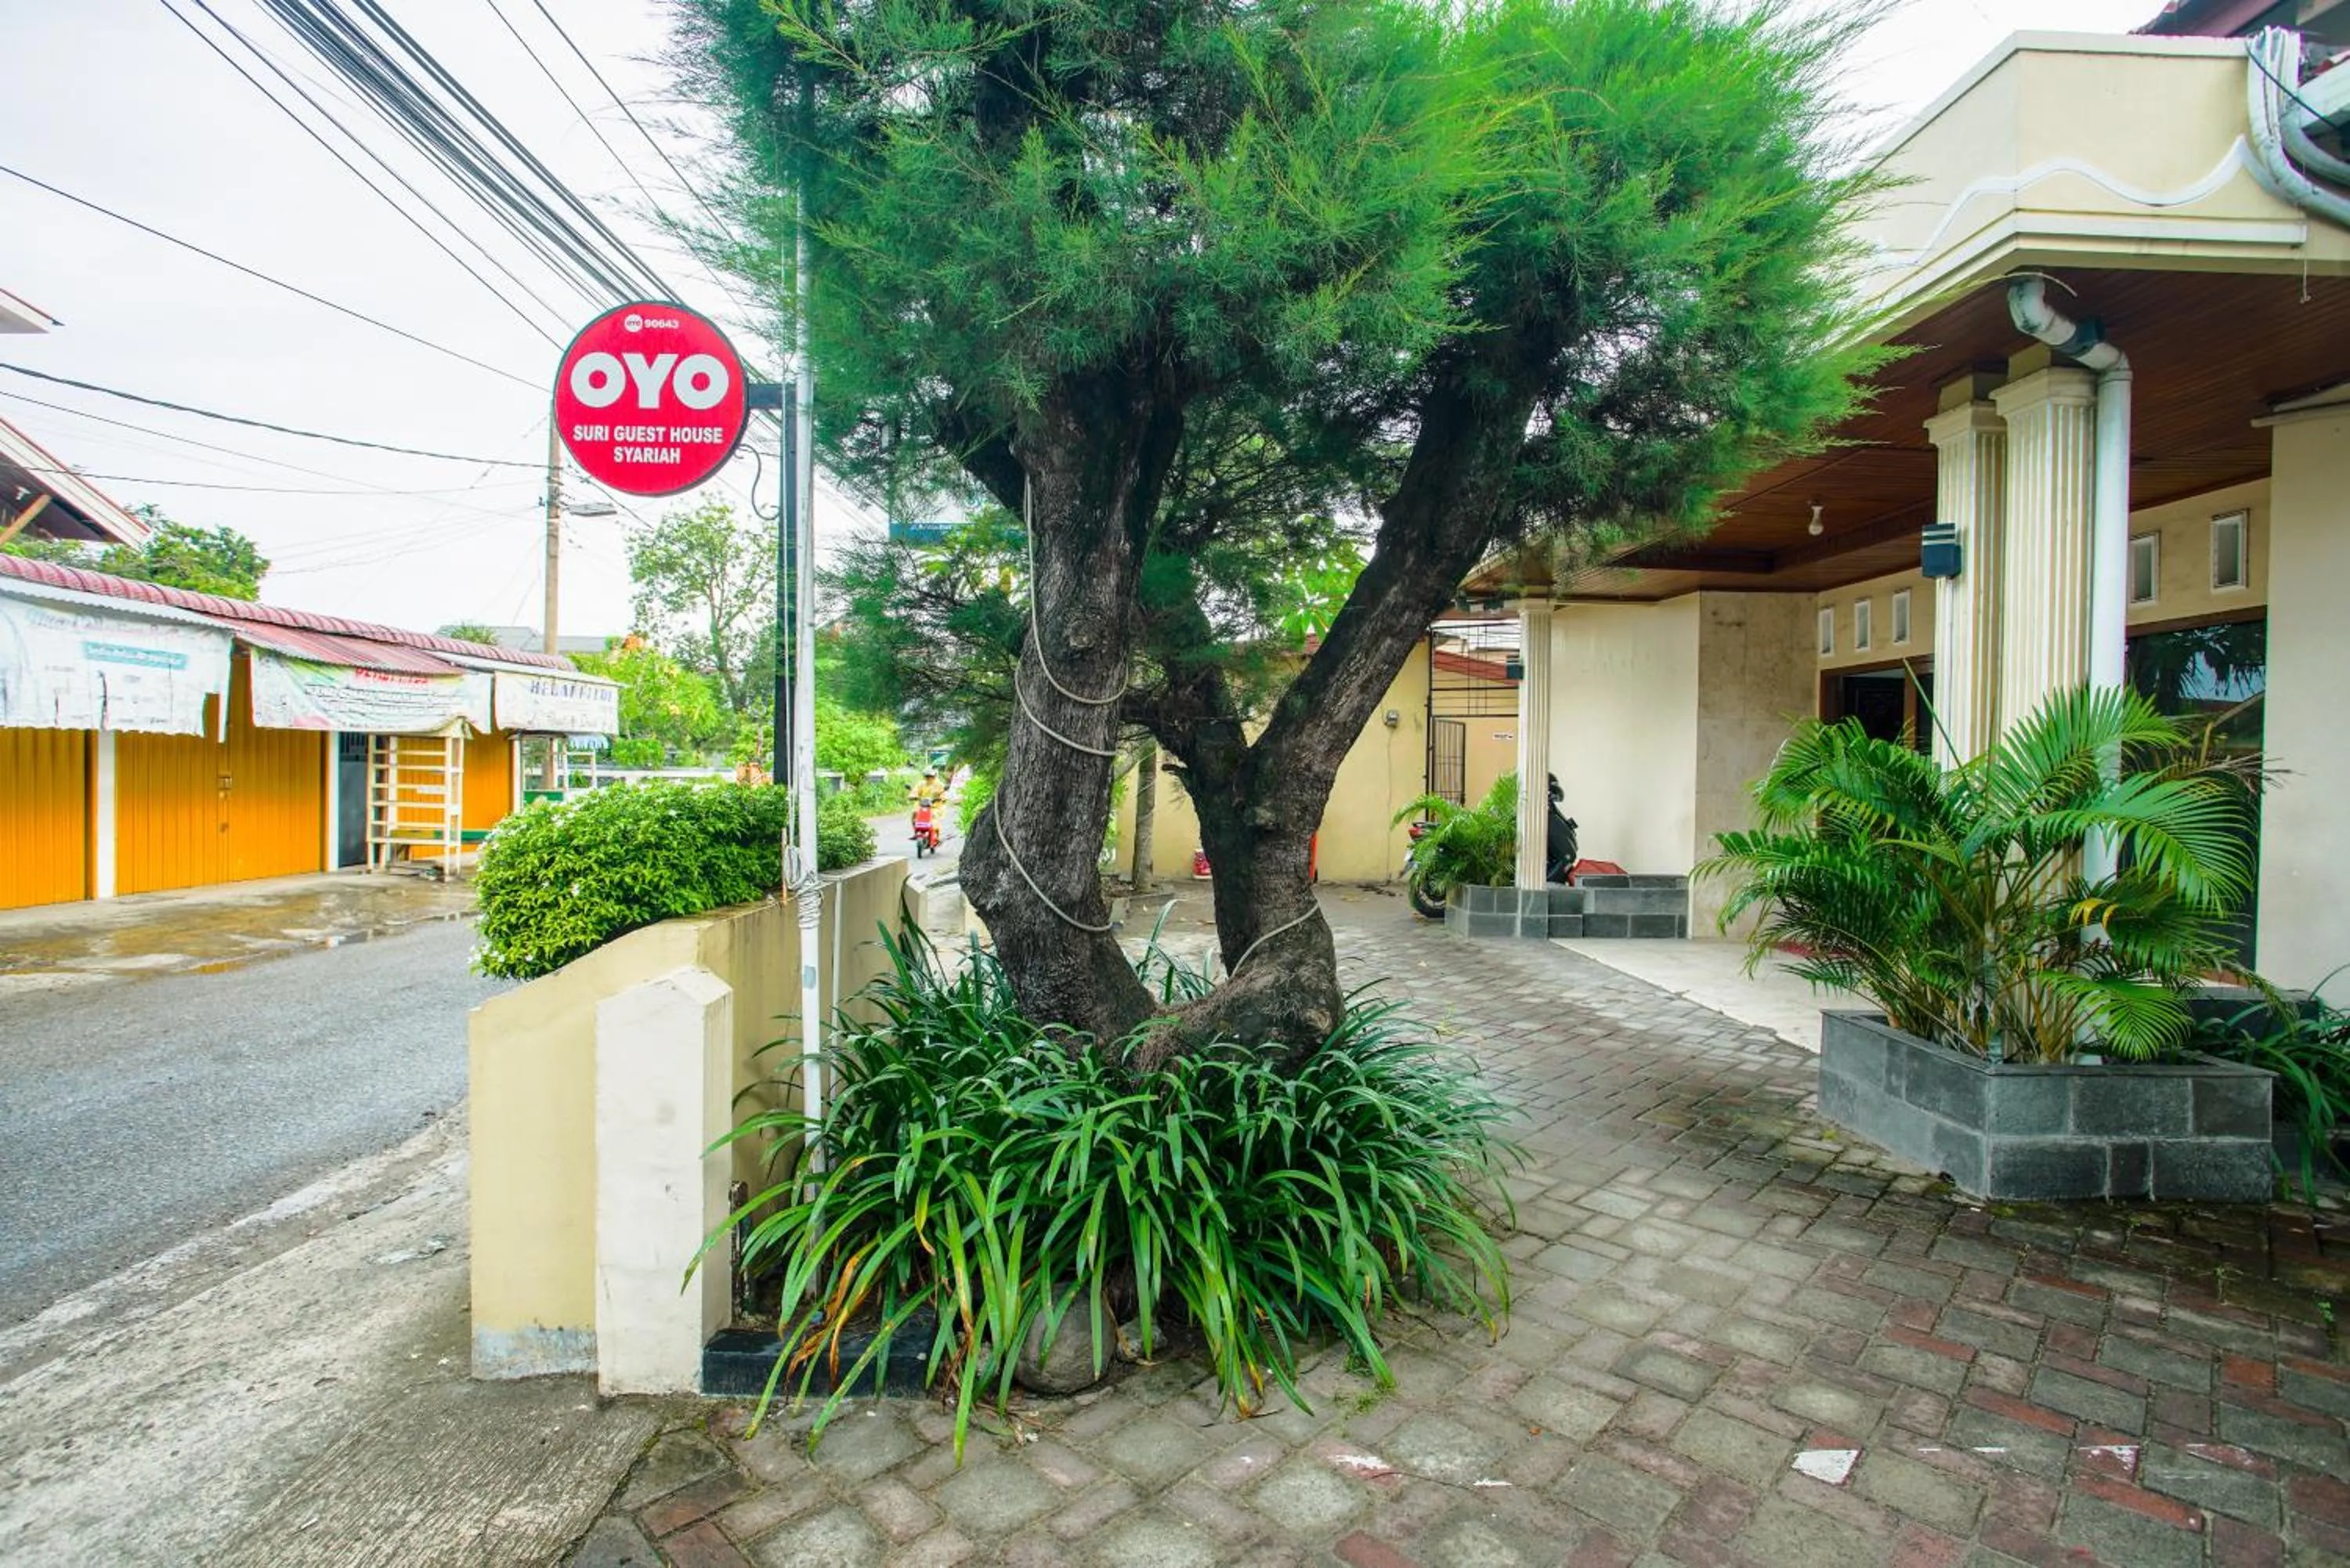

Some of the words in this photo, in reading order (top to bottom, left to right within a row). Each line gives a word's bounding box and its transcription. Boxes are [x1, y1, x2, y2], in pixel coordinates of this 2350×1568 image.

[570, 352, 729, 410] OYO
[573, 425, 609, 442] SURI
[614, 426, 665, 443] GUEST
[670, 427, 723, 443] HOUSE
[613, 447, 681, 464] SYARIAH
